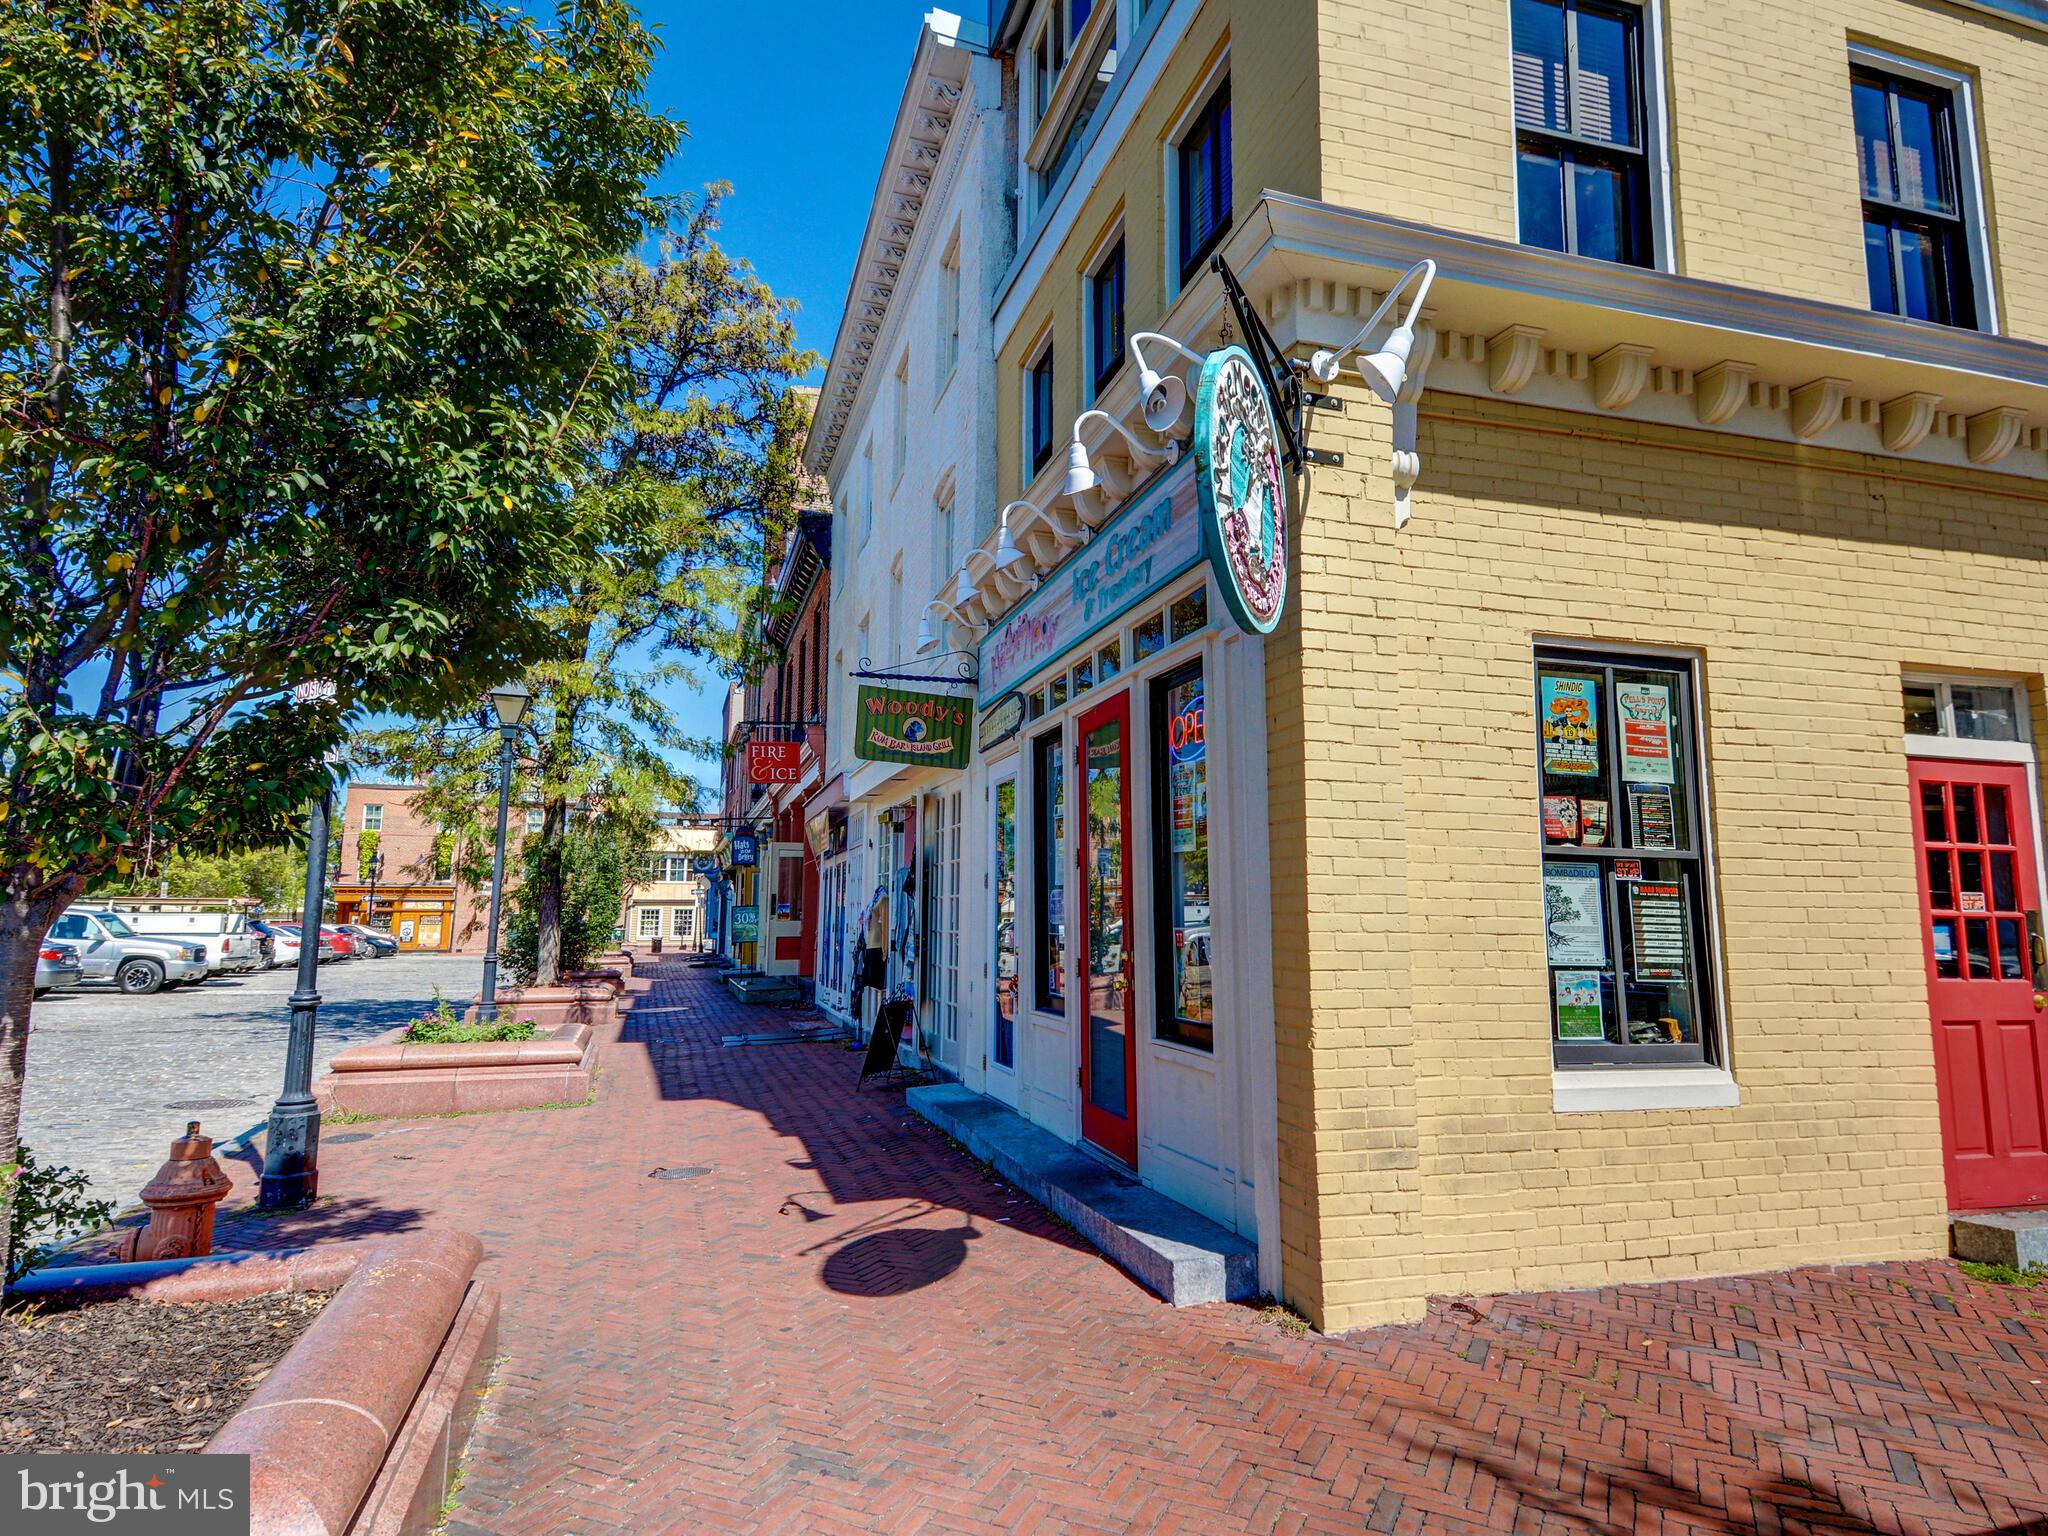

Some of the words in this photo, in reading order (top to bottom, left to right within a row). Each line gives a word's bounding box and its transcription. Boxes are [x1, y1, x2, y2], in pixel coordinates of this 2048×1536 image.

[1072, 560, 1100, 605] Ice
[1105, 497, 1173, 577] Cream
[1555, 680, 1583, 693] SHINDIG
[864, 696, 966, 726] Woody's
[1171, 709, 1206, 750] OPE
[870, 731, 889, 746] RUM
[889, 740, 907, 750] BAR
[911, 743, 933, 752] ISLAND
[933, 741, 951, 751] GRILL
[751, 745, 786, 761] FIRE
[751, 758, 774, 781] &
[770, 768, 797, 780] ICE
[734, 840, 750, 850] Hats
[1546, 869, 1596, 878] BOMBADILLO
[1617, 868, 1640, 878] STOP
